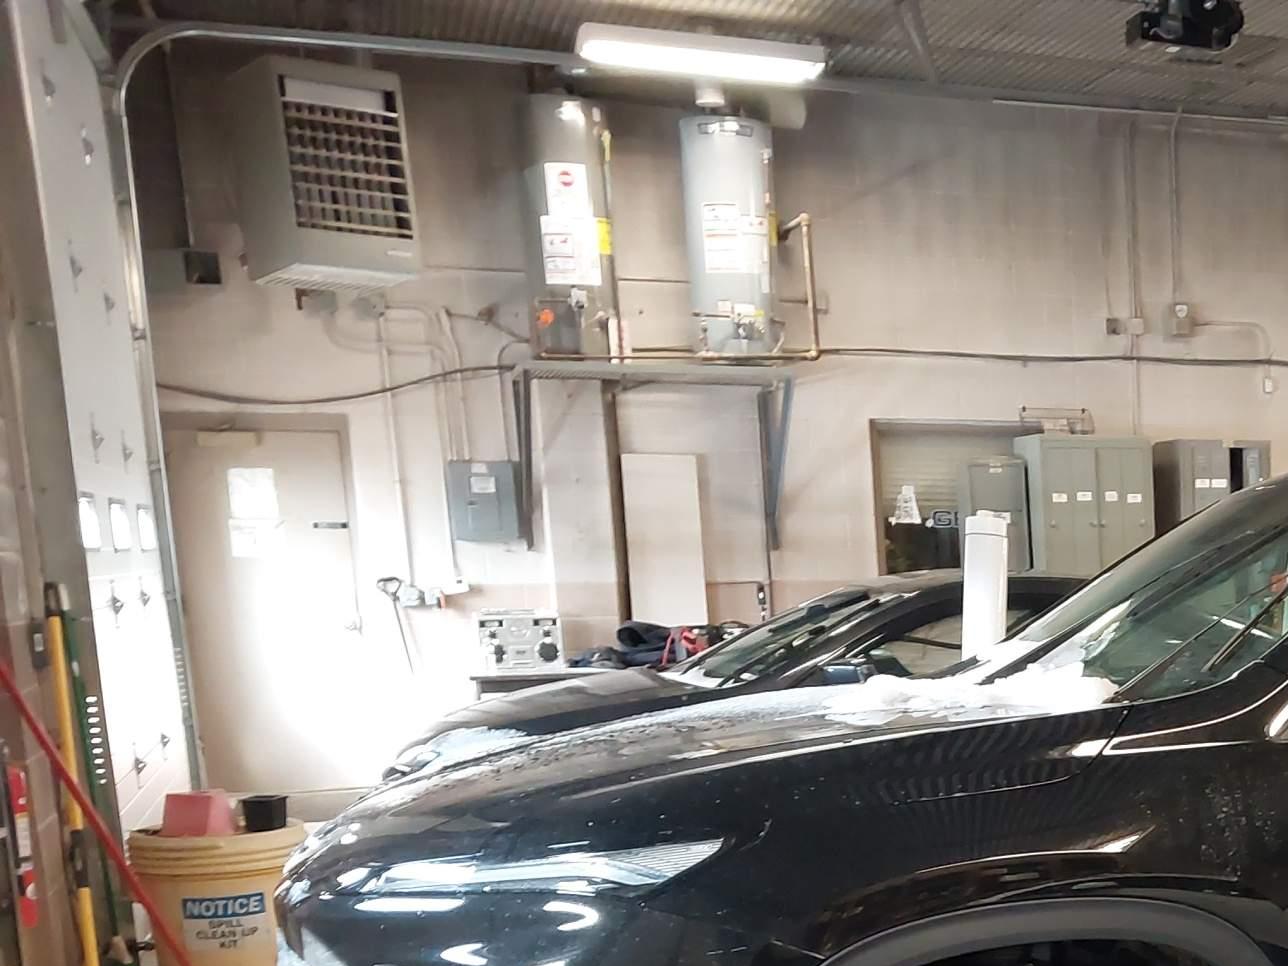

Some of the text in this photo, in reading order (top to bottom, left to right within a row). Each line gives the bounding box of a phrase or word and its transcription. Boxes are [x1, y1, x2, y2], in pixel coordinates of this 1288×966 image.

[185, 896, 262, 917] NOTICE
[208, 919, 243, 929] SPILL
[196, 926, 258, 940] CLEAN UP
[219, 939, 238, 949] KIT
